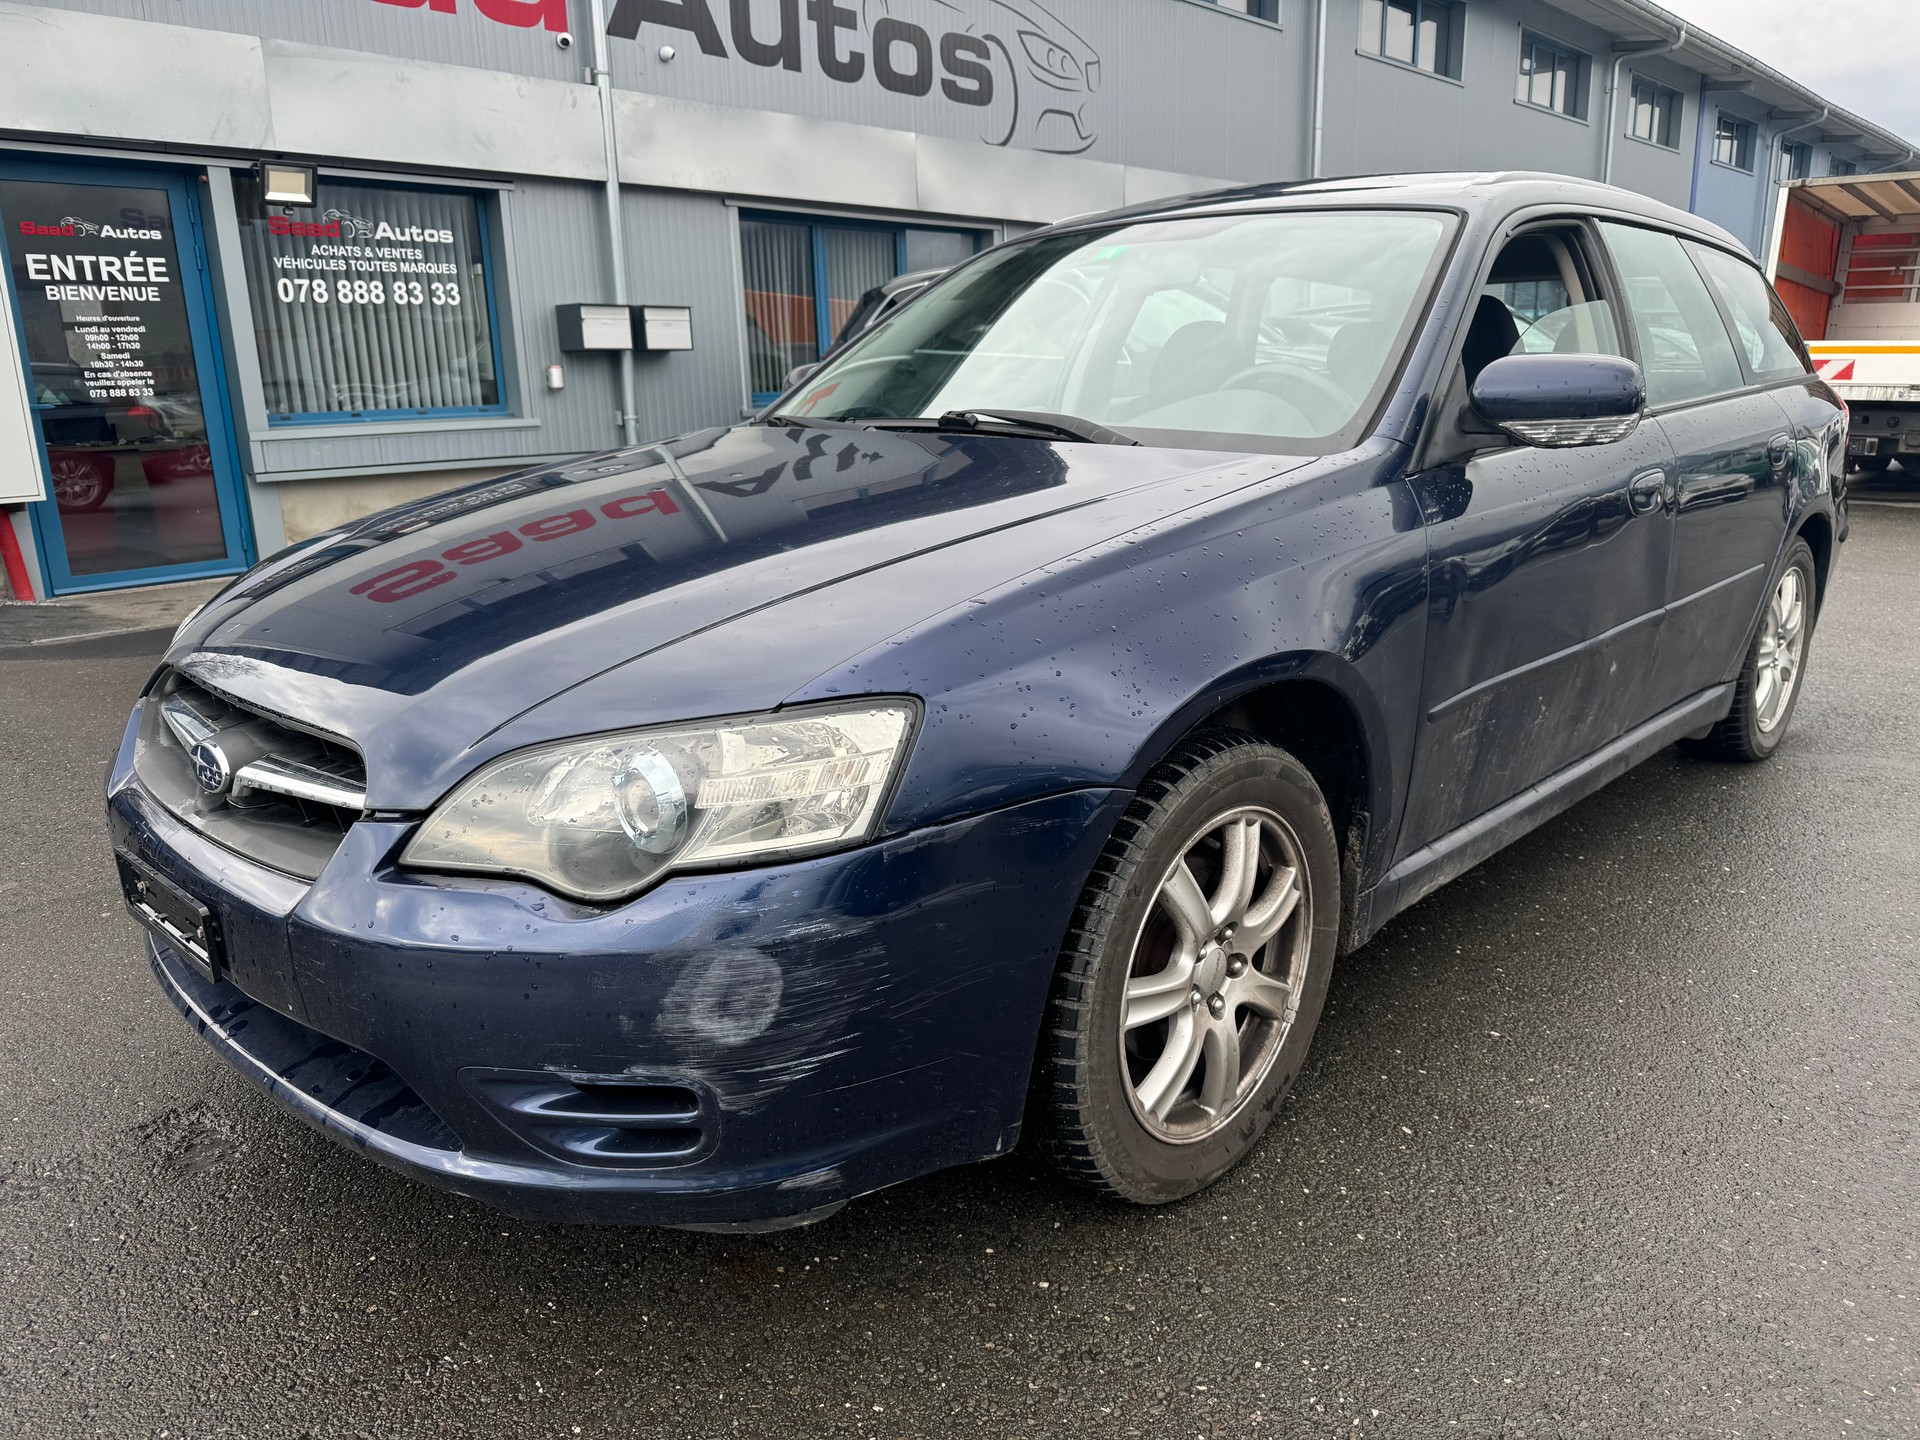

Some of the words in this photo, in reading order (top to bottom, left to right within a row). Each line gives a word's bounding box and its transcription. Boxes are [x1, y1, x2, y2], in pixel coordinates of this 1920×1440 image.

[19, 221, 75, 237] Saad
[100, 224, 163, 240] Autos
[268, 215, 341, 238] Saad
[374, 221, 455, 244] Autos
[311, 244, 362, 258] ACHATS
[364, 247, 374, 258] &
[375, 247, 423, 260] VENTES
[25, 250, 170, 283] ENTRÉE
[273, 255, 347, 271] VÉHICULES
[349, 259, 398, 273] TOUTES
[400, 262, 457, 275] MARQUES
[44, 285, 161, 302] BIENVENUE
[277, 277, 329, 304] 078
[336, 279, 386, 305] 888
[392, 281, 424, 306] 83
[431, 281, 461, 306] 33
[111, 325, 146, 333] vendredi
[100, 352, 131, 360] Samedi
[113, 370, 152, 378] d'absence
[84, 379, 115, 387] veuillez
[117, 378, 146, 387] appeler
[89, 389, 107, 398] 078
[109, 388, 126, 397] 888
[128, 388, 140, 396] 83
[142, 387, 154, 396] 33
